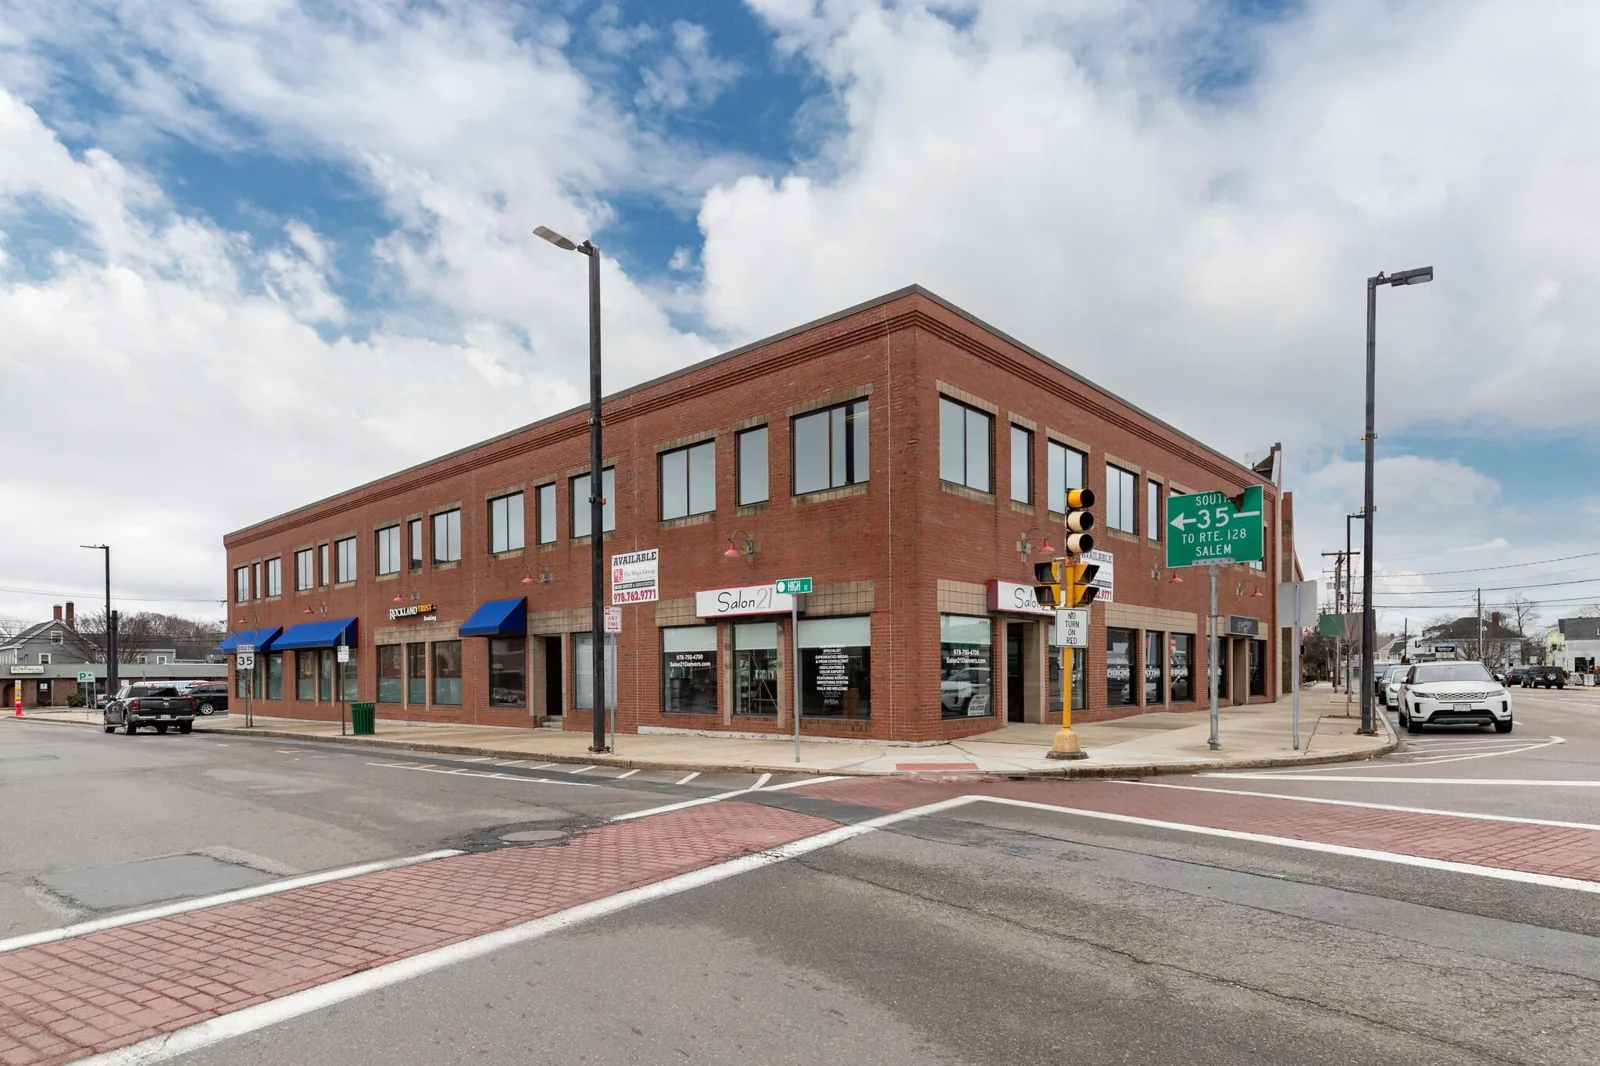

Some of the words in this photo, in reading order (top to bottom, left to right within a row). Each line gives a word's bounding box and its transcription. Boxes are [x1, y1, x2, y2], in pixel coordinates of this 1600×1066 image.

[1197, 507, 1229, 529] 35
[1182, 533, 1195, 544] TO
[1199, 531, 1223, 543] RTE.
[1227, 528, 1247, 540] 128
[1195, 544, 1232, 557] SALEM
[613, 551, 657, 567] AVAILABLE
[787, 580, 801, 592] HIGH
[613, 588, 657, 603] 978.762.9771
[717, 590, 755, 613] Salon
[755, 587, 773, 609] 21
[1014, 588, 1040, 609] Salo
[389, 606, 418, 620] ROCKLAND
[418, 604, 432, 613] TRUST
[1066, 637, 1078, 645] RED
[238, 656, 253, 666] 35
[79, 672, 87, 680] P
